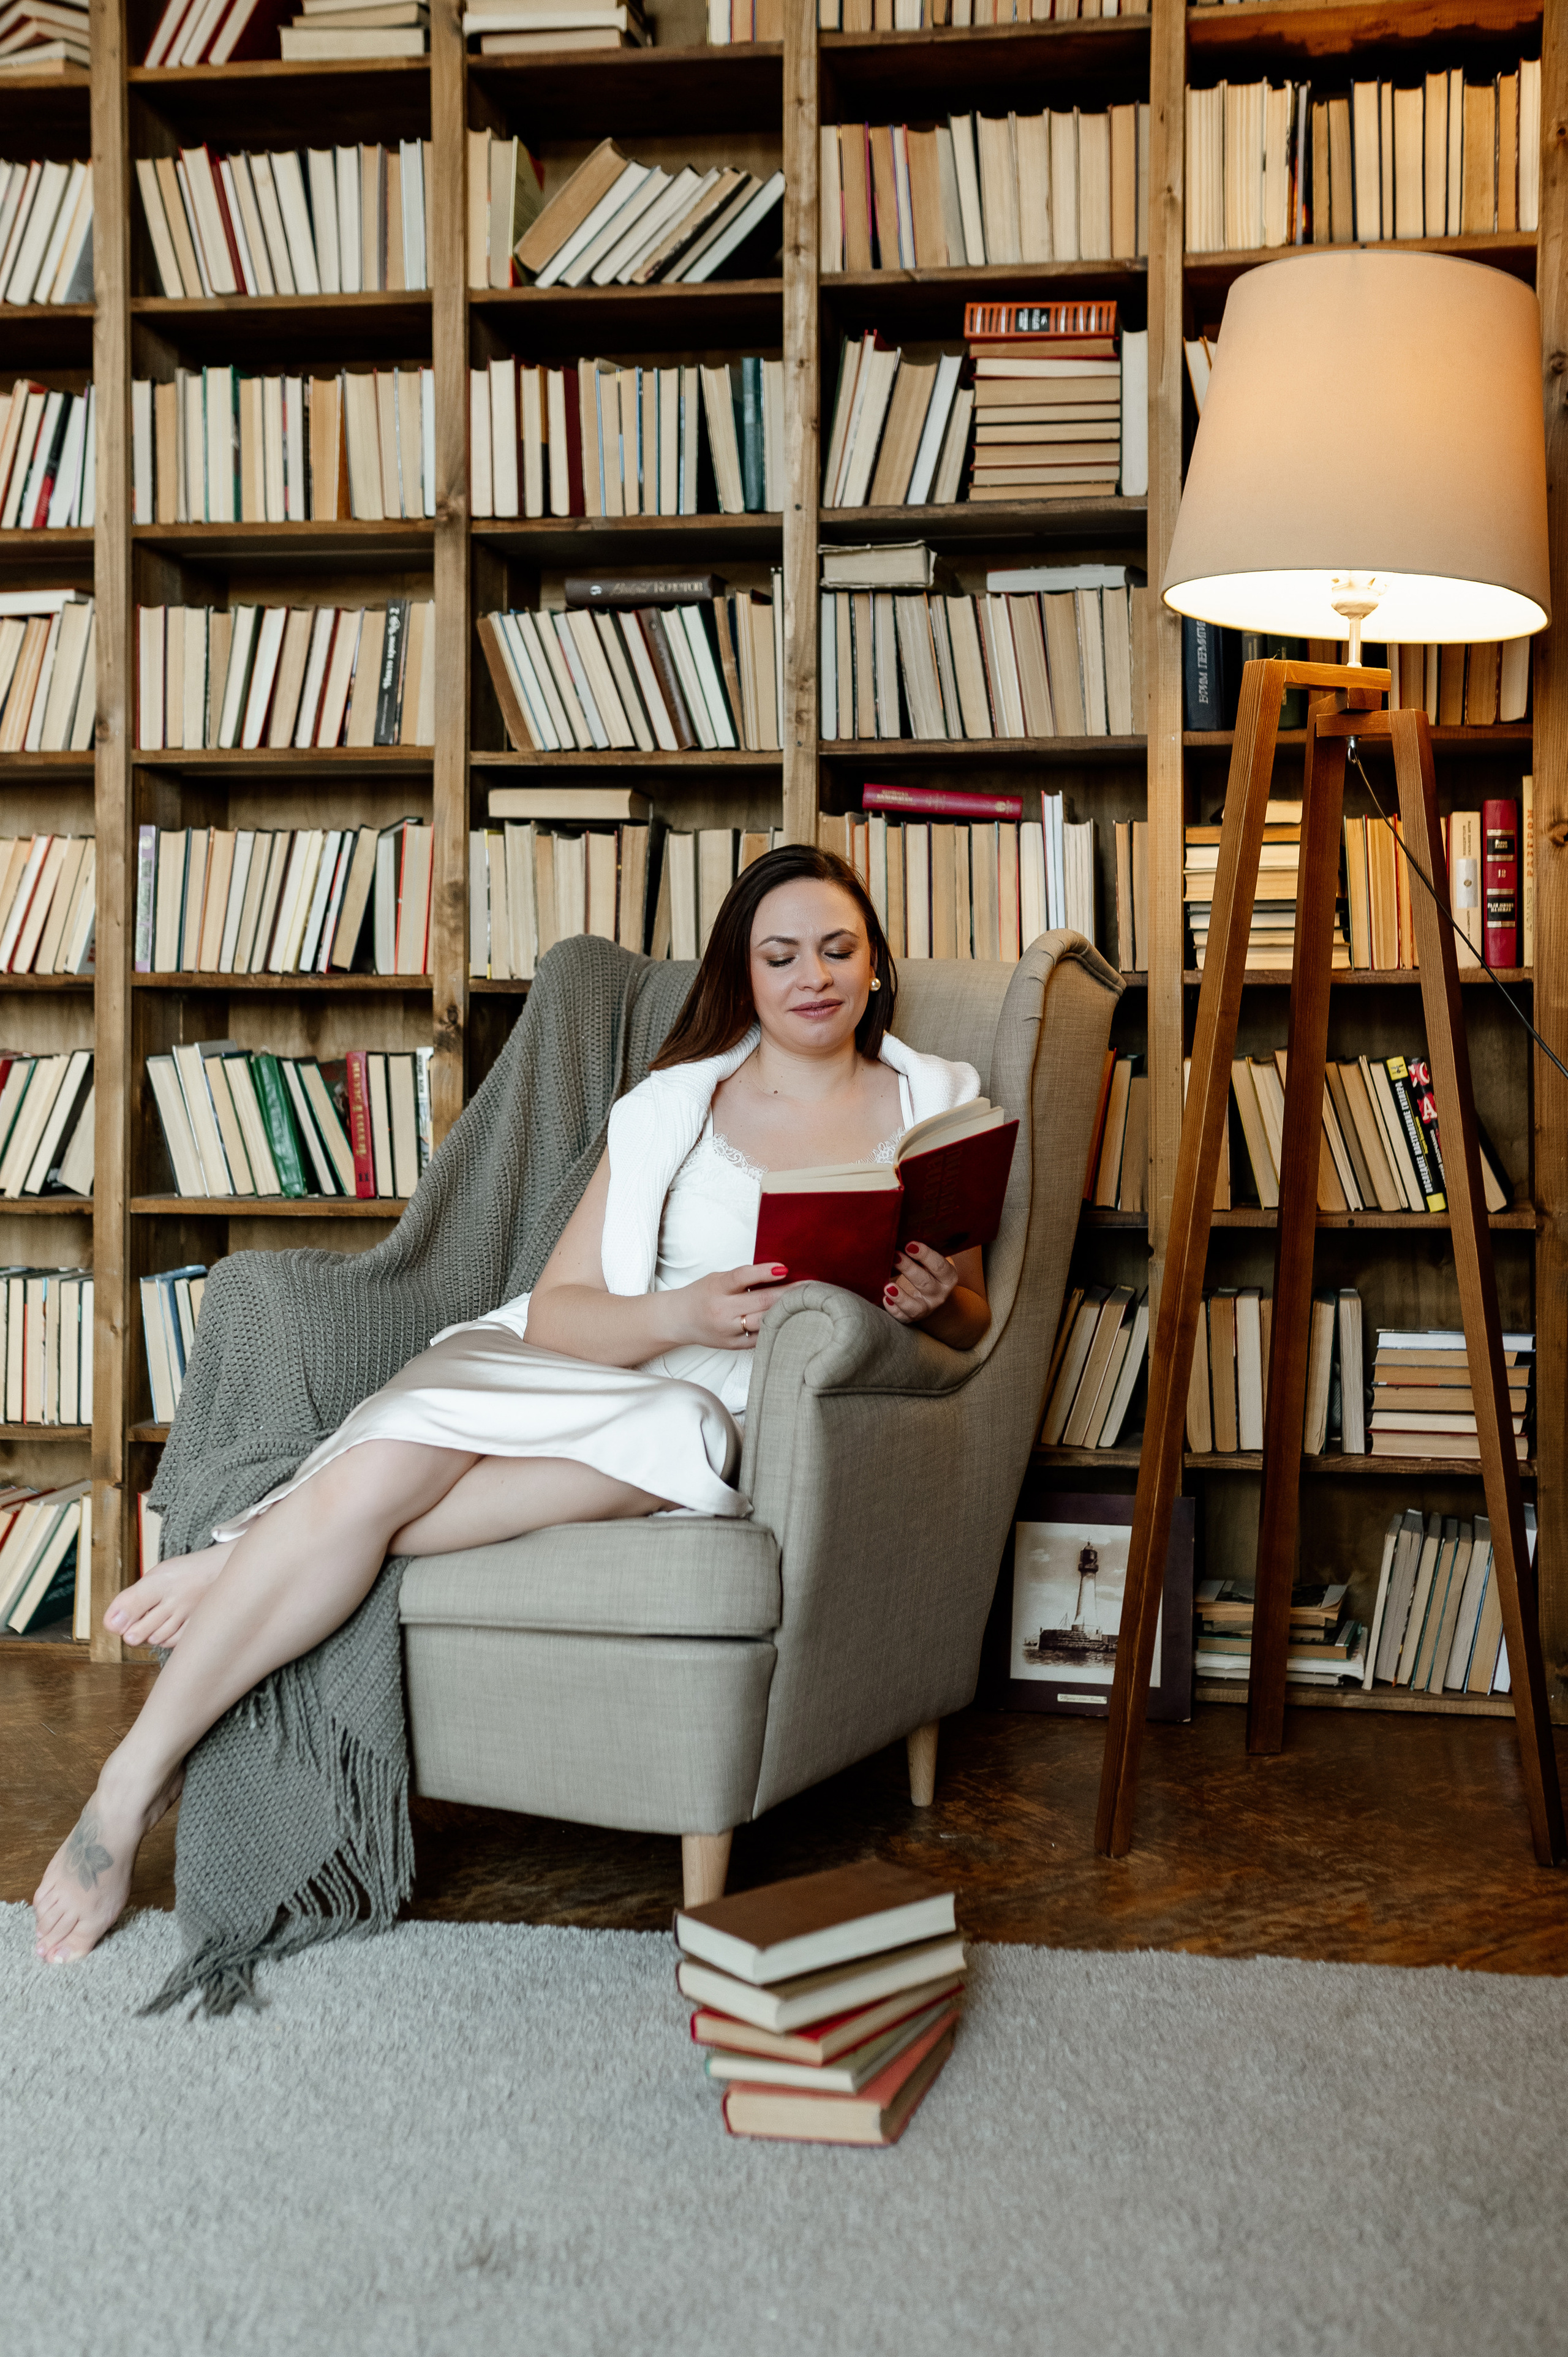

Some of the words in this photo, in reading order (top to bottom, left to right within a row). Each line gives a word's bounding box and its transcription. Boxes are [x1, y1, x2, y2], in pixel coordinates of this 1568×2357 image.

[1395, 1081, 1409, 1111] ГИТЛЕРА
[1403, 1109, 1422, 1156] НАСТУПЛЕНИЕ
[1416, 1154, 1433, 1193] ПОСЛЕДНЕЕ
